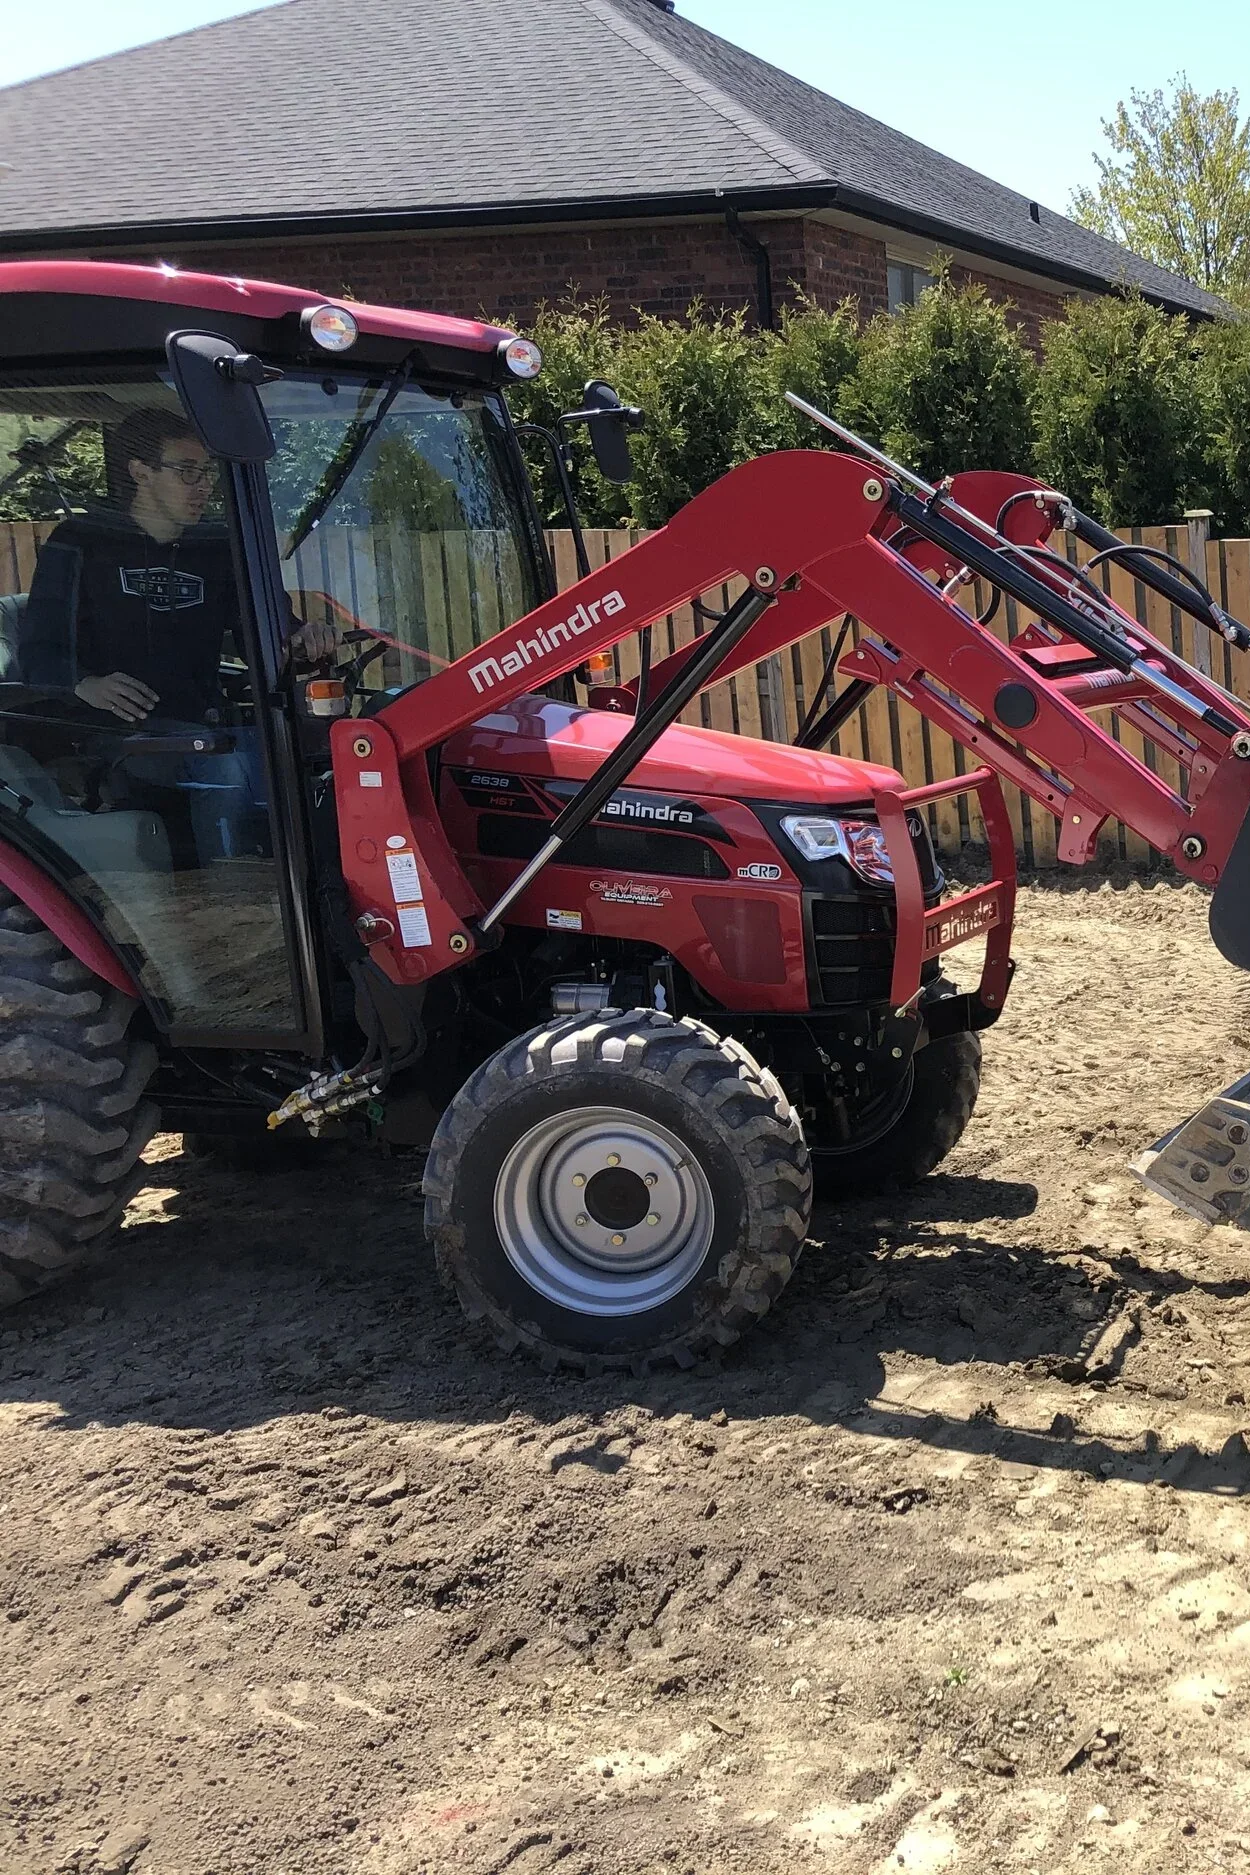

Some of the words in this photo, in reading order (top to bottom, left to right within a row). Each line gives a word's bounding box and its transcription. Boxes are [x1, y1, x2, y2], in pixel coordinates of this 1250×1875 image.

[467, 590, 627, 694] Mahindra
[470, 775, 510, 788] 2638
[589, 879, 674, 899] OLIVEIRA
[604, 892, 659, 902] EQUIPMENT
[926, 901, 998, 951] Mahindra
